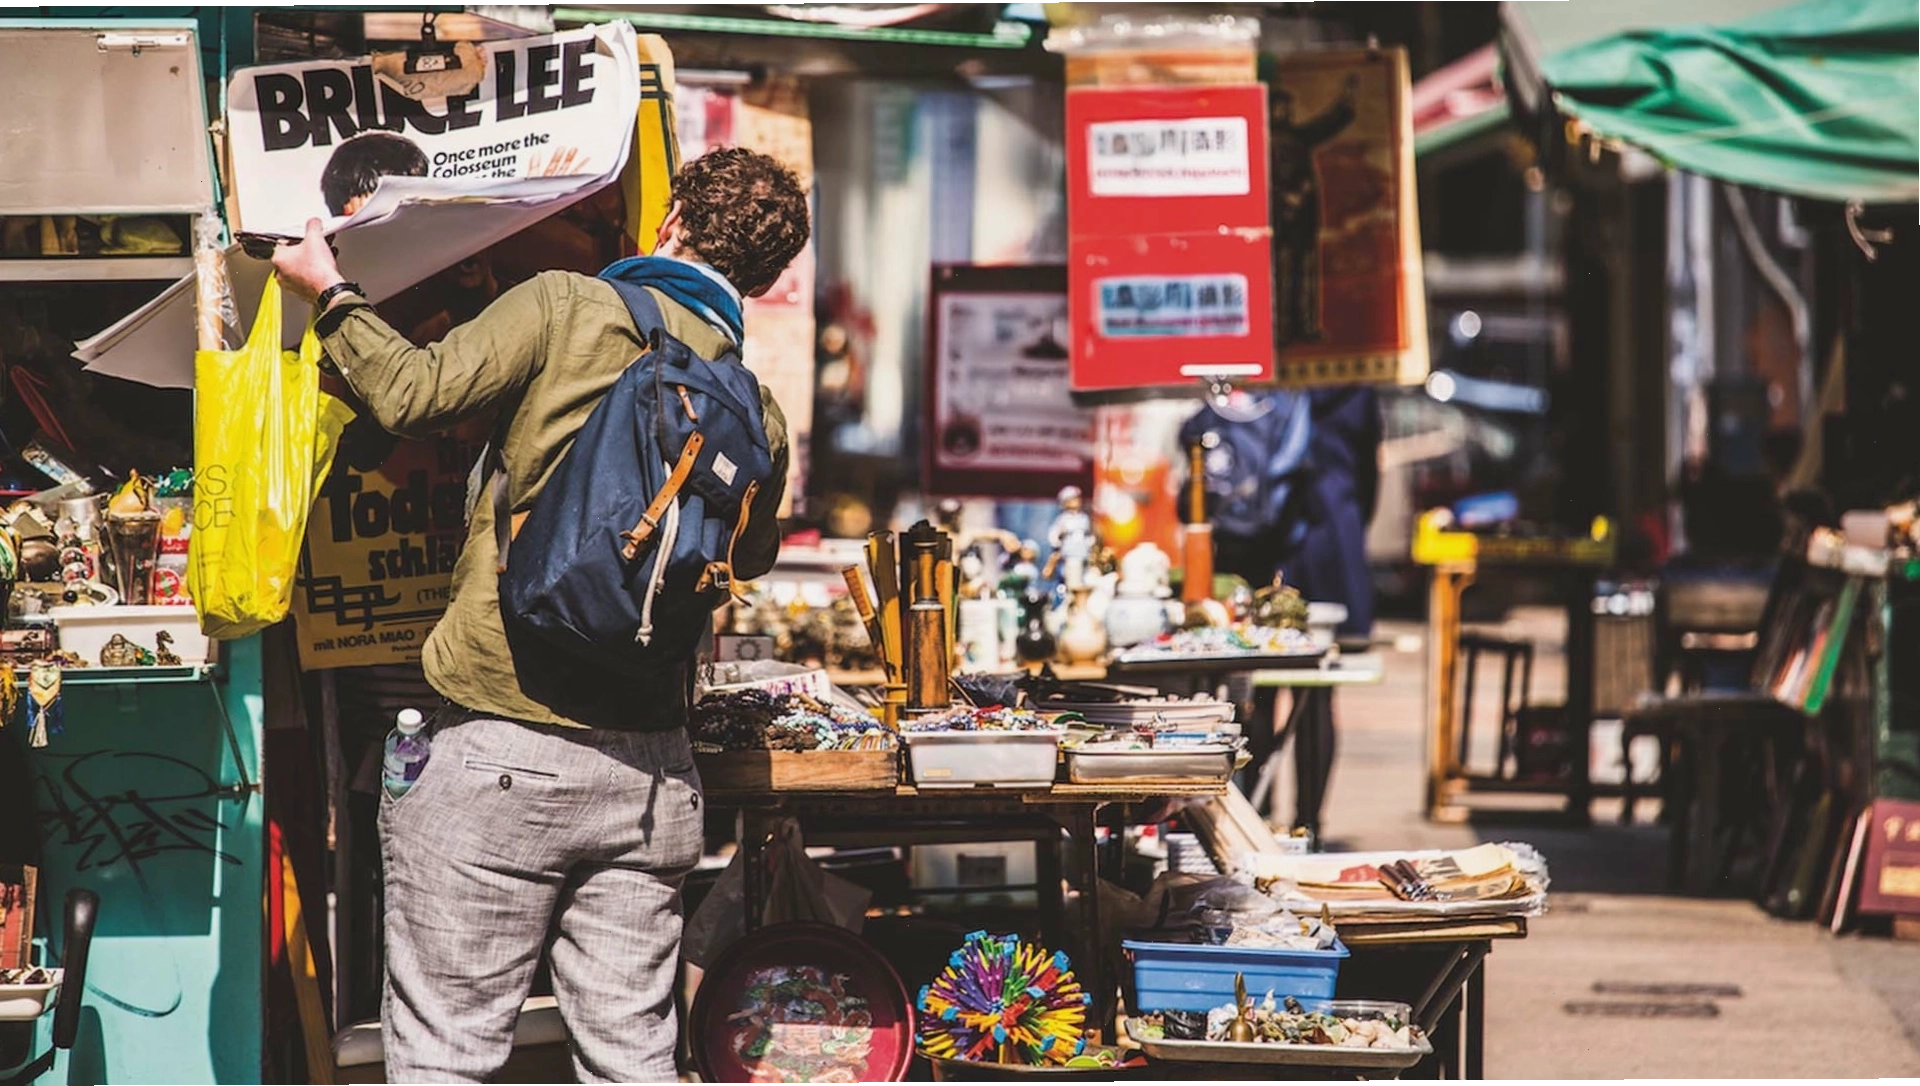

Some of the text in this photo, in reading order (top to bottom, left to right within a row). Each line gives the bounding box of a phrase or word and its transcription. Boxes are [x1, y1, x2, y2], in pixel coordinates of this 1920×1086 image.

[494, 37, 597, 122] LEE
[433, 132, 550, 165] Once more the
[433, 155, 517, 178] Colosseum
[314, 636, 334, 651] mit
[337, 634, 377, 649] NORA
[379, 629, 415, 644] MIAO
